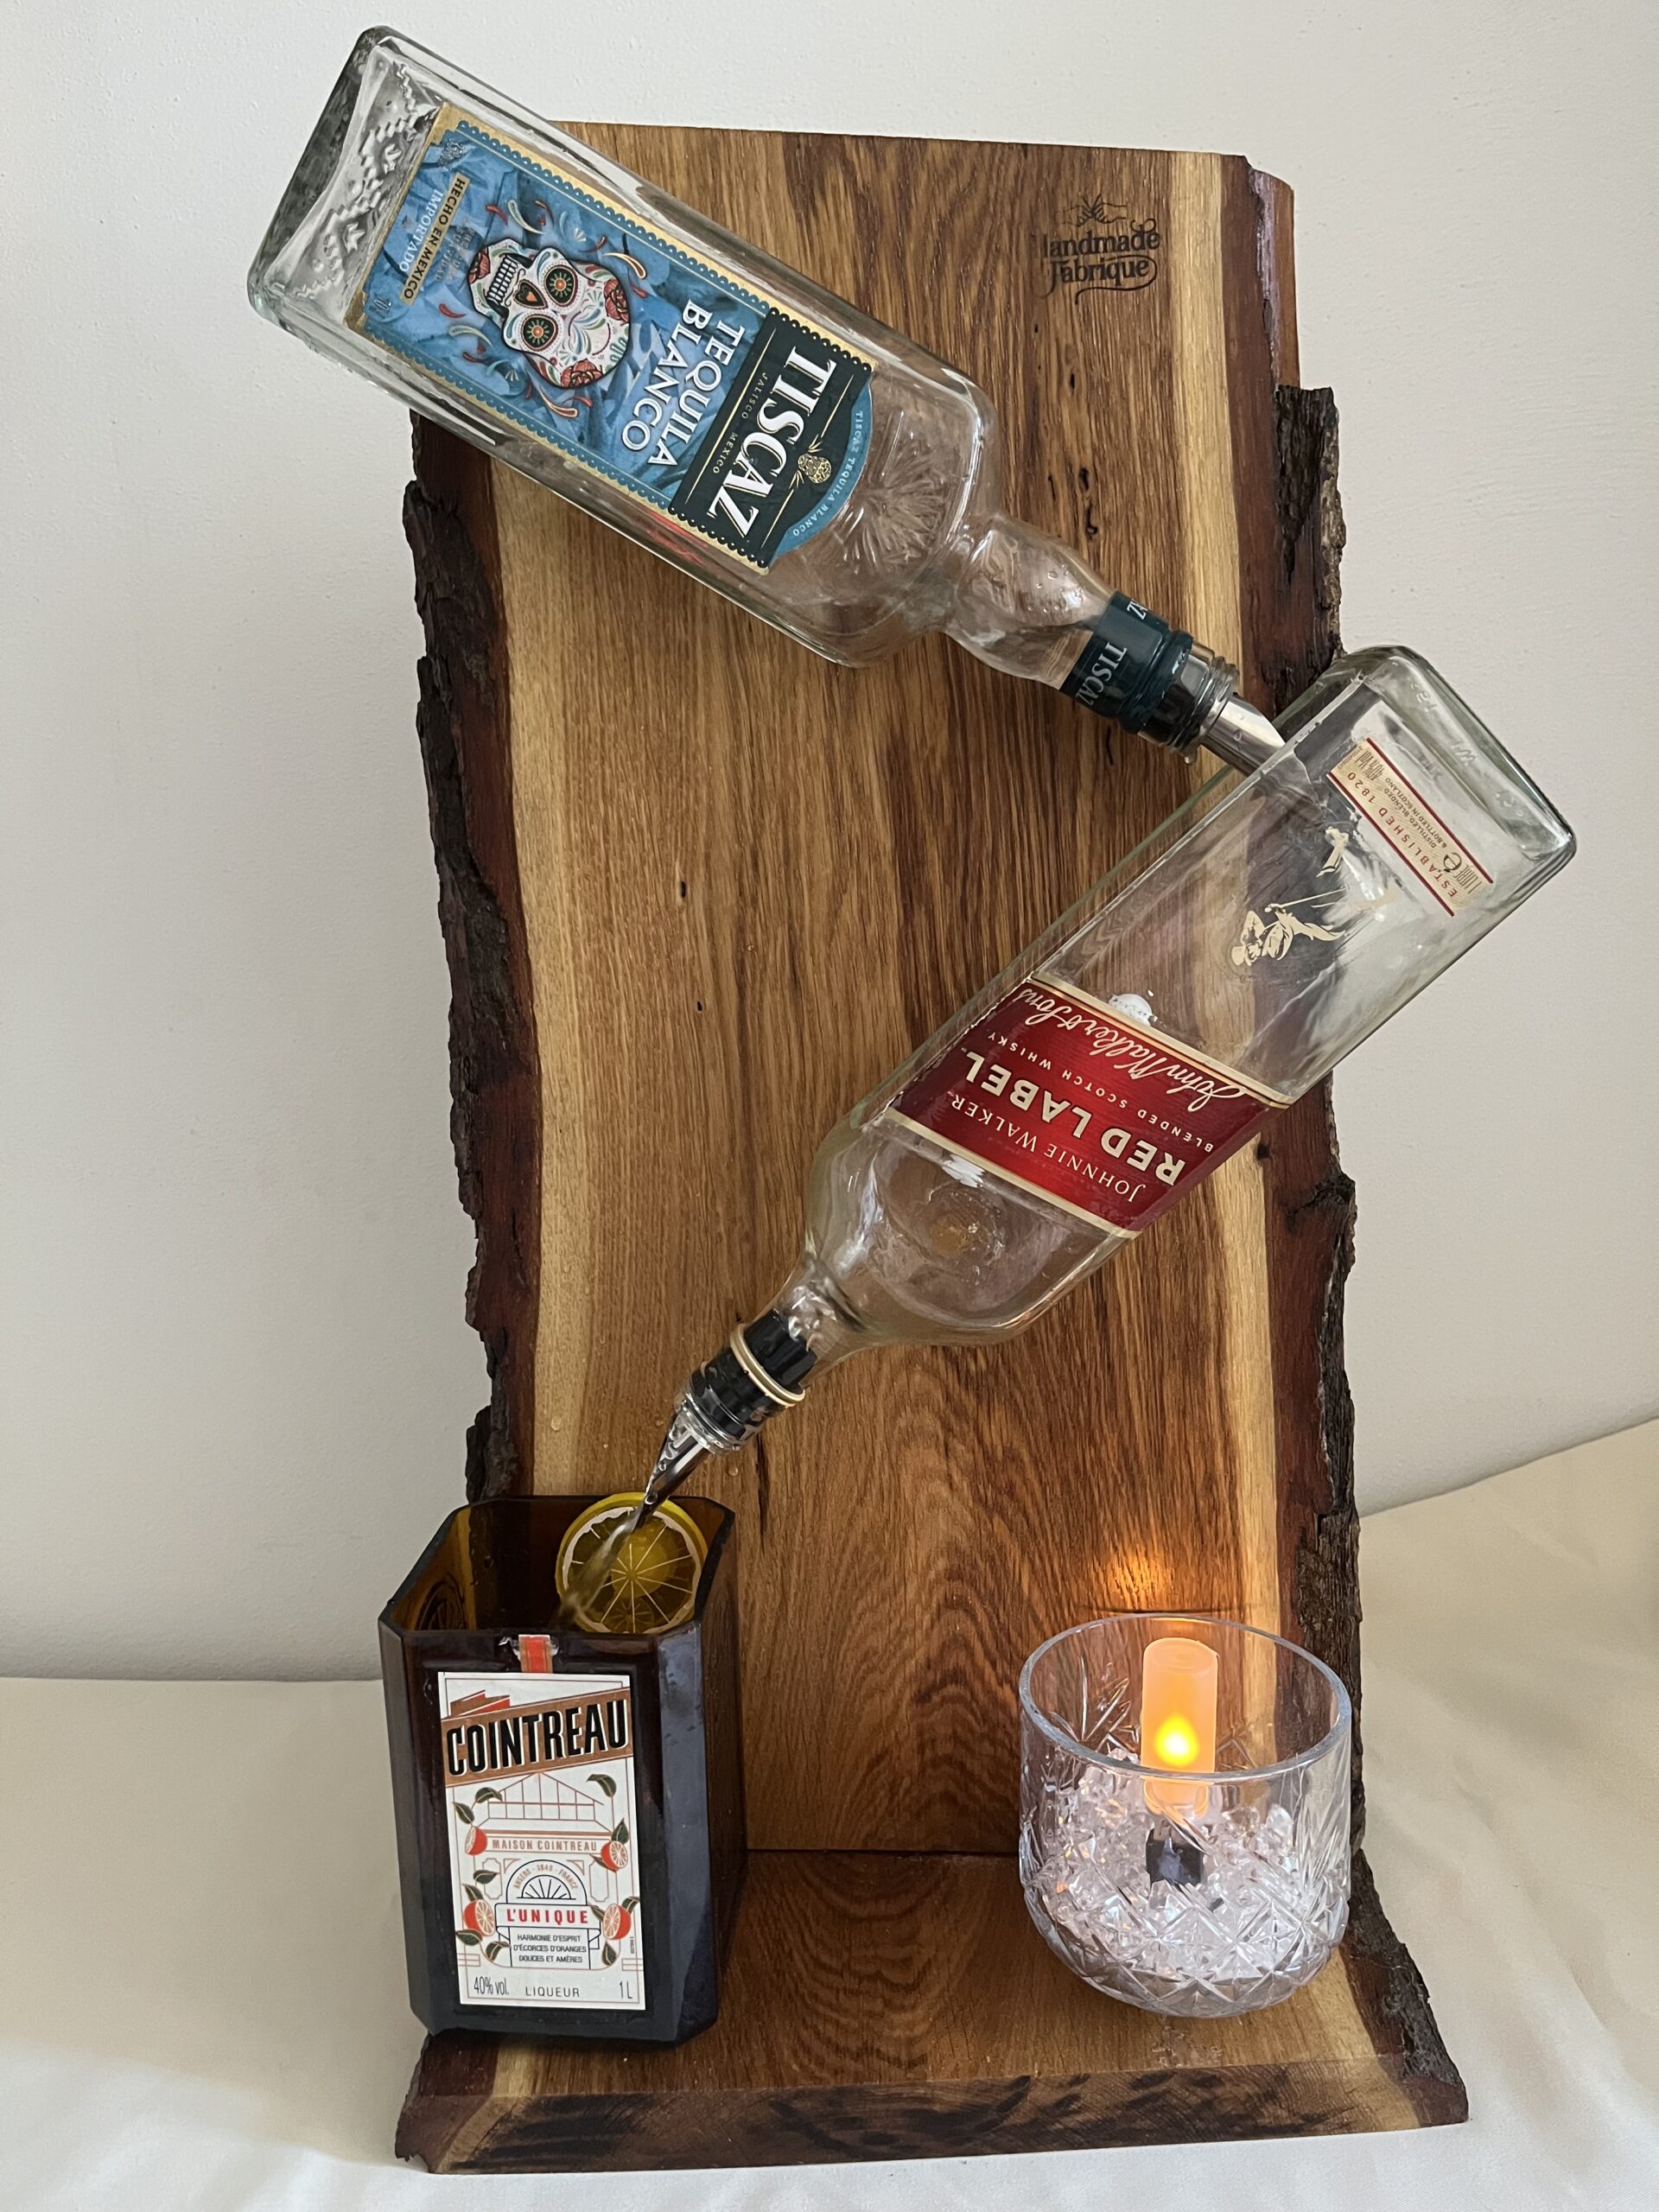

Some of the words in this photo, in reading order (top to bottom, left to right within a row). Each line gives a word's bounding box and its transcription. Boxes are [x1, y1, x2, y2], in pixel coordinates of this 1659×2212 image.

[439, 178, 466, 226] HECHO
[399, 190, 443, 271] IMPORTADO
[427, 227, 442, 246] EN
[404, 248, 434, 299] MEXICO
[622, 300, 713, 451] BLANCO
[646, 320, 745, 465] TEQUILA
[741, 372, 769, 420] JALISCO
[707, 346, 836, 537] TISCAZ
[713, 432, 739, 474] MEXICO
[851, 410, 863, 454] TISCAZ
[828, 457, 855, 502] TEQUILA
[793, 504, 829, 537] BLANCO
[1076, 642, 1127, 706] TISCAZ
[1348, 772, 1375, 803] 1820
[1364, 759, 1385, 782] 40%
[1384, 788, 1410, 817] BLENDED
[1385, 778, 1413, 810] SCOTLAND
[1411, 807, 1421, 817] IN
[1418, 816, 1443, 843] BOTTLED
[1379, 807, 1457, 897] ESTABLISHED
[1012, 986, 1065, 1025] Sons
[988, 1032, 1052, 1070] WHISKY
[1076, 1018, 1163, 1077] Walker
[966, 1051, 1092, 1138] LABEL
[1062, 1070, 1128, 1109] SCOTCH
[1165, 1063, 1243, 1109] John
[951, 1093, 1037, 1151] WALKER
[1137, 1109, 1213, 1152] BLENDED
[1045, 1143, 1146, 1202] JOHNNIE
[1100, 1128, 1185, 1185] RED
[446, 1700, 629, 1777] COINTREAU
[492, 1839, 532, 1849] MAISON
[537, 1840, 596, 1851] COINTREAU
[506, 1909, 588, 1924] L'UNIQUE
[474, 1976, 493, 1994] 40%
[494, 1978, 509, 1995] vol.
[524, 1986, 579, 1998] LIQUEUR
